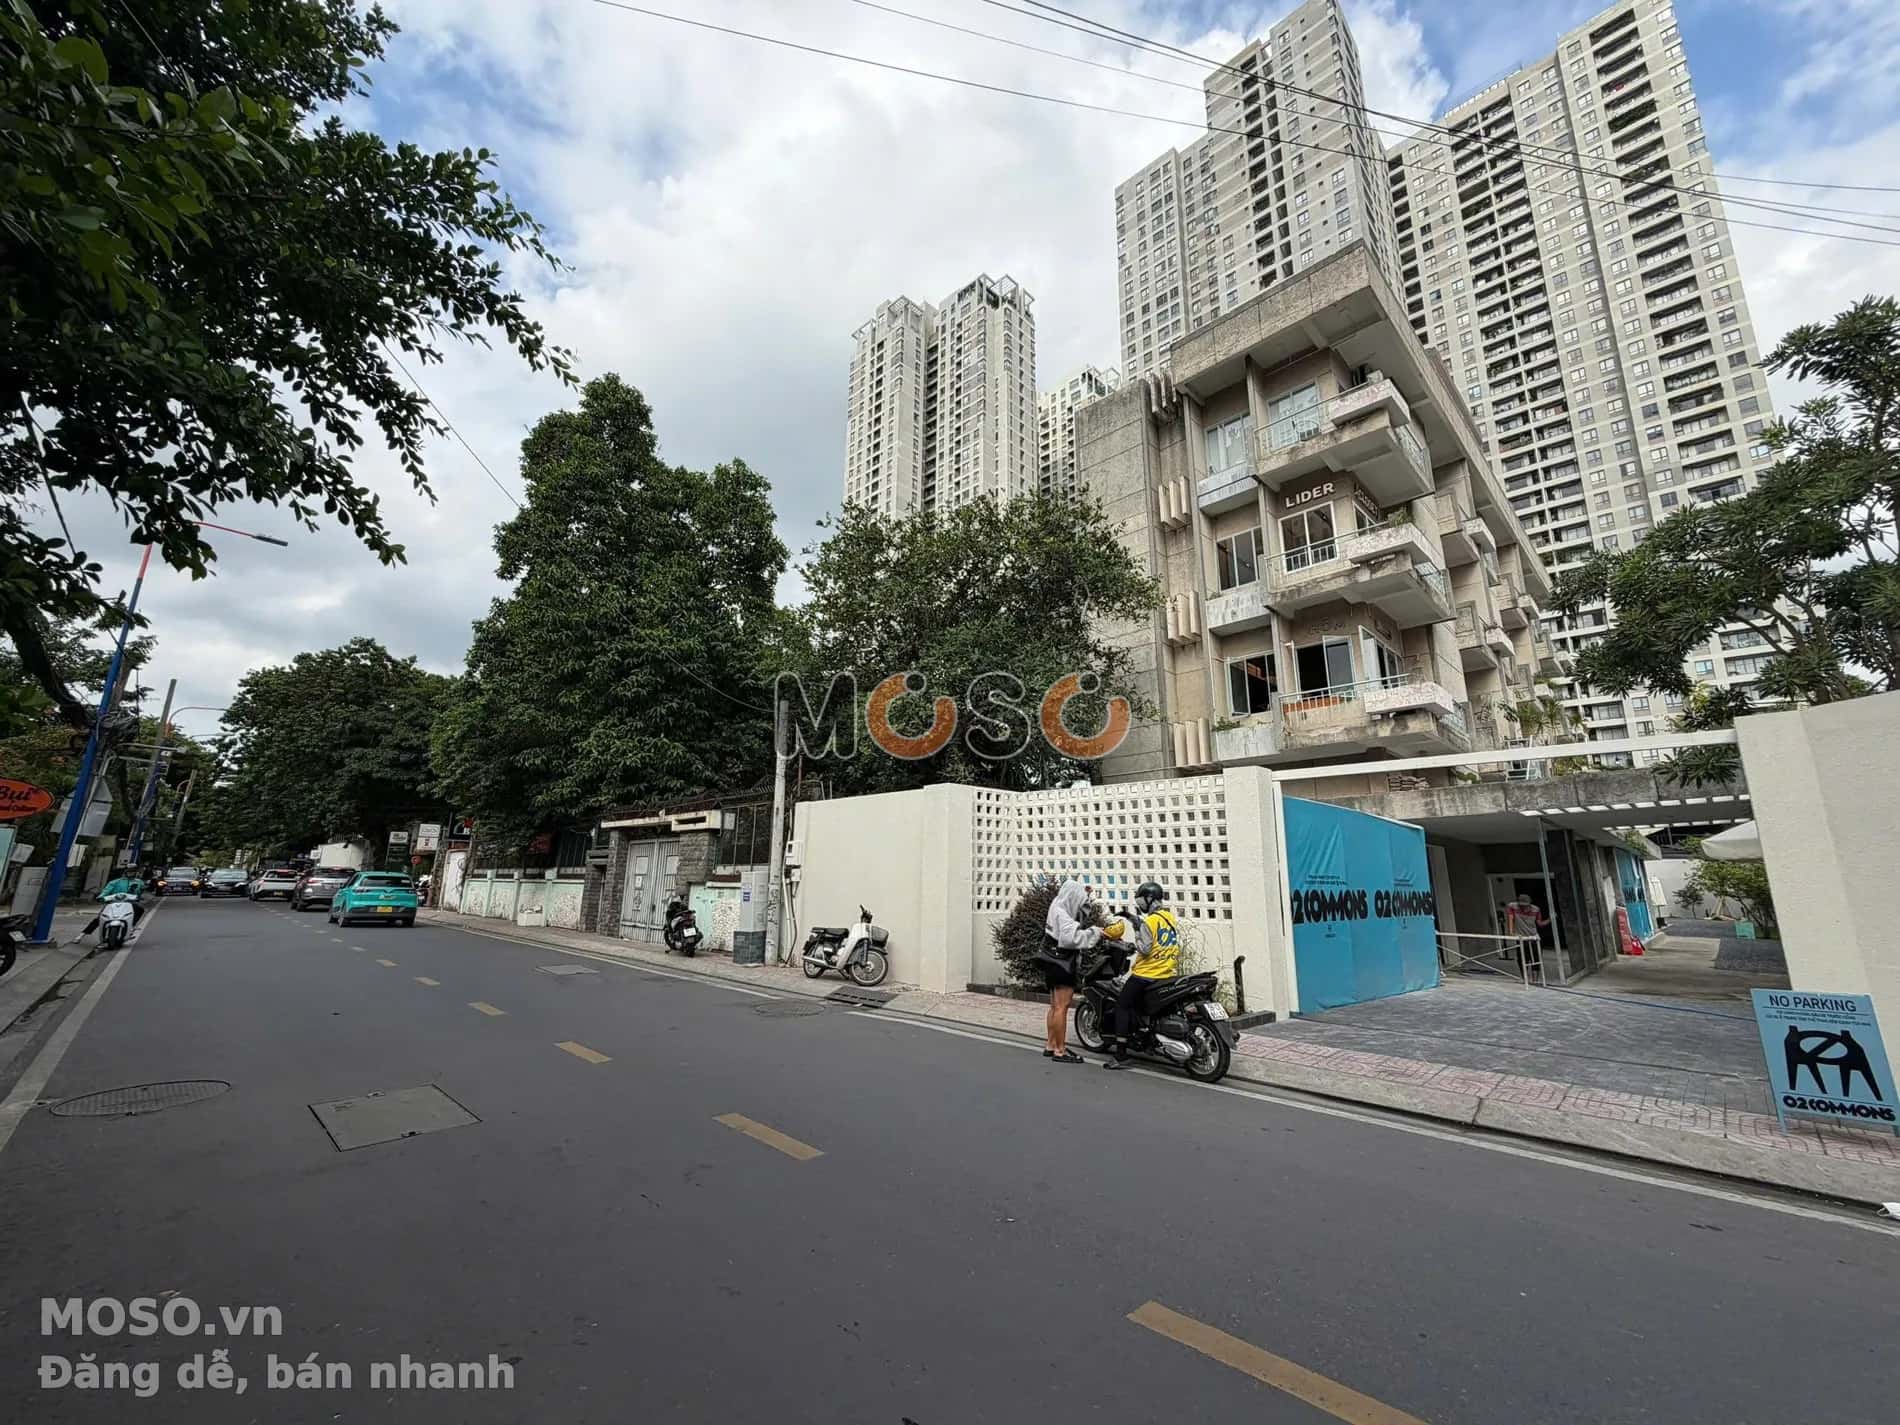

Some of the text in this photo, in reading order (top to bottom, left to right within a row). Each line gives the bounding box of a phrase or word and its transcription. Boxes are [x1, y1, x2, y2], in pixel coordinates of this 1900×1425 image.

[1285, 482, 1335, 508] LIDER
[1290, 889, 1369, 924] 2COMMONS
[1769, 994, 1857, 1012] NO PARKING
